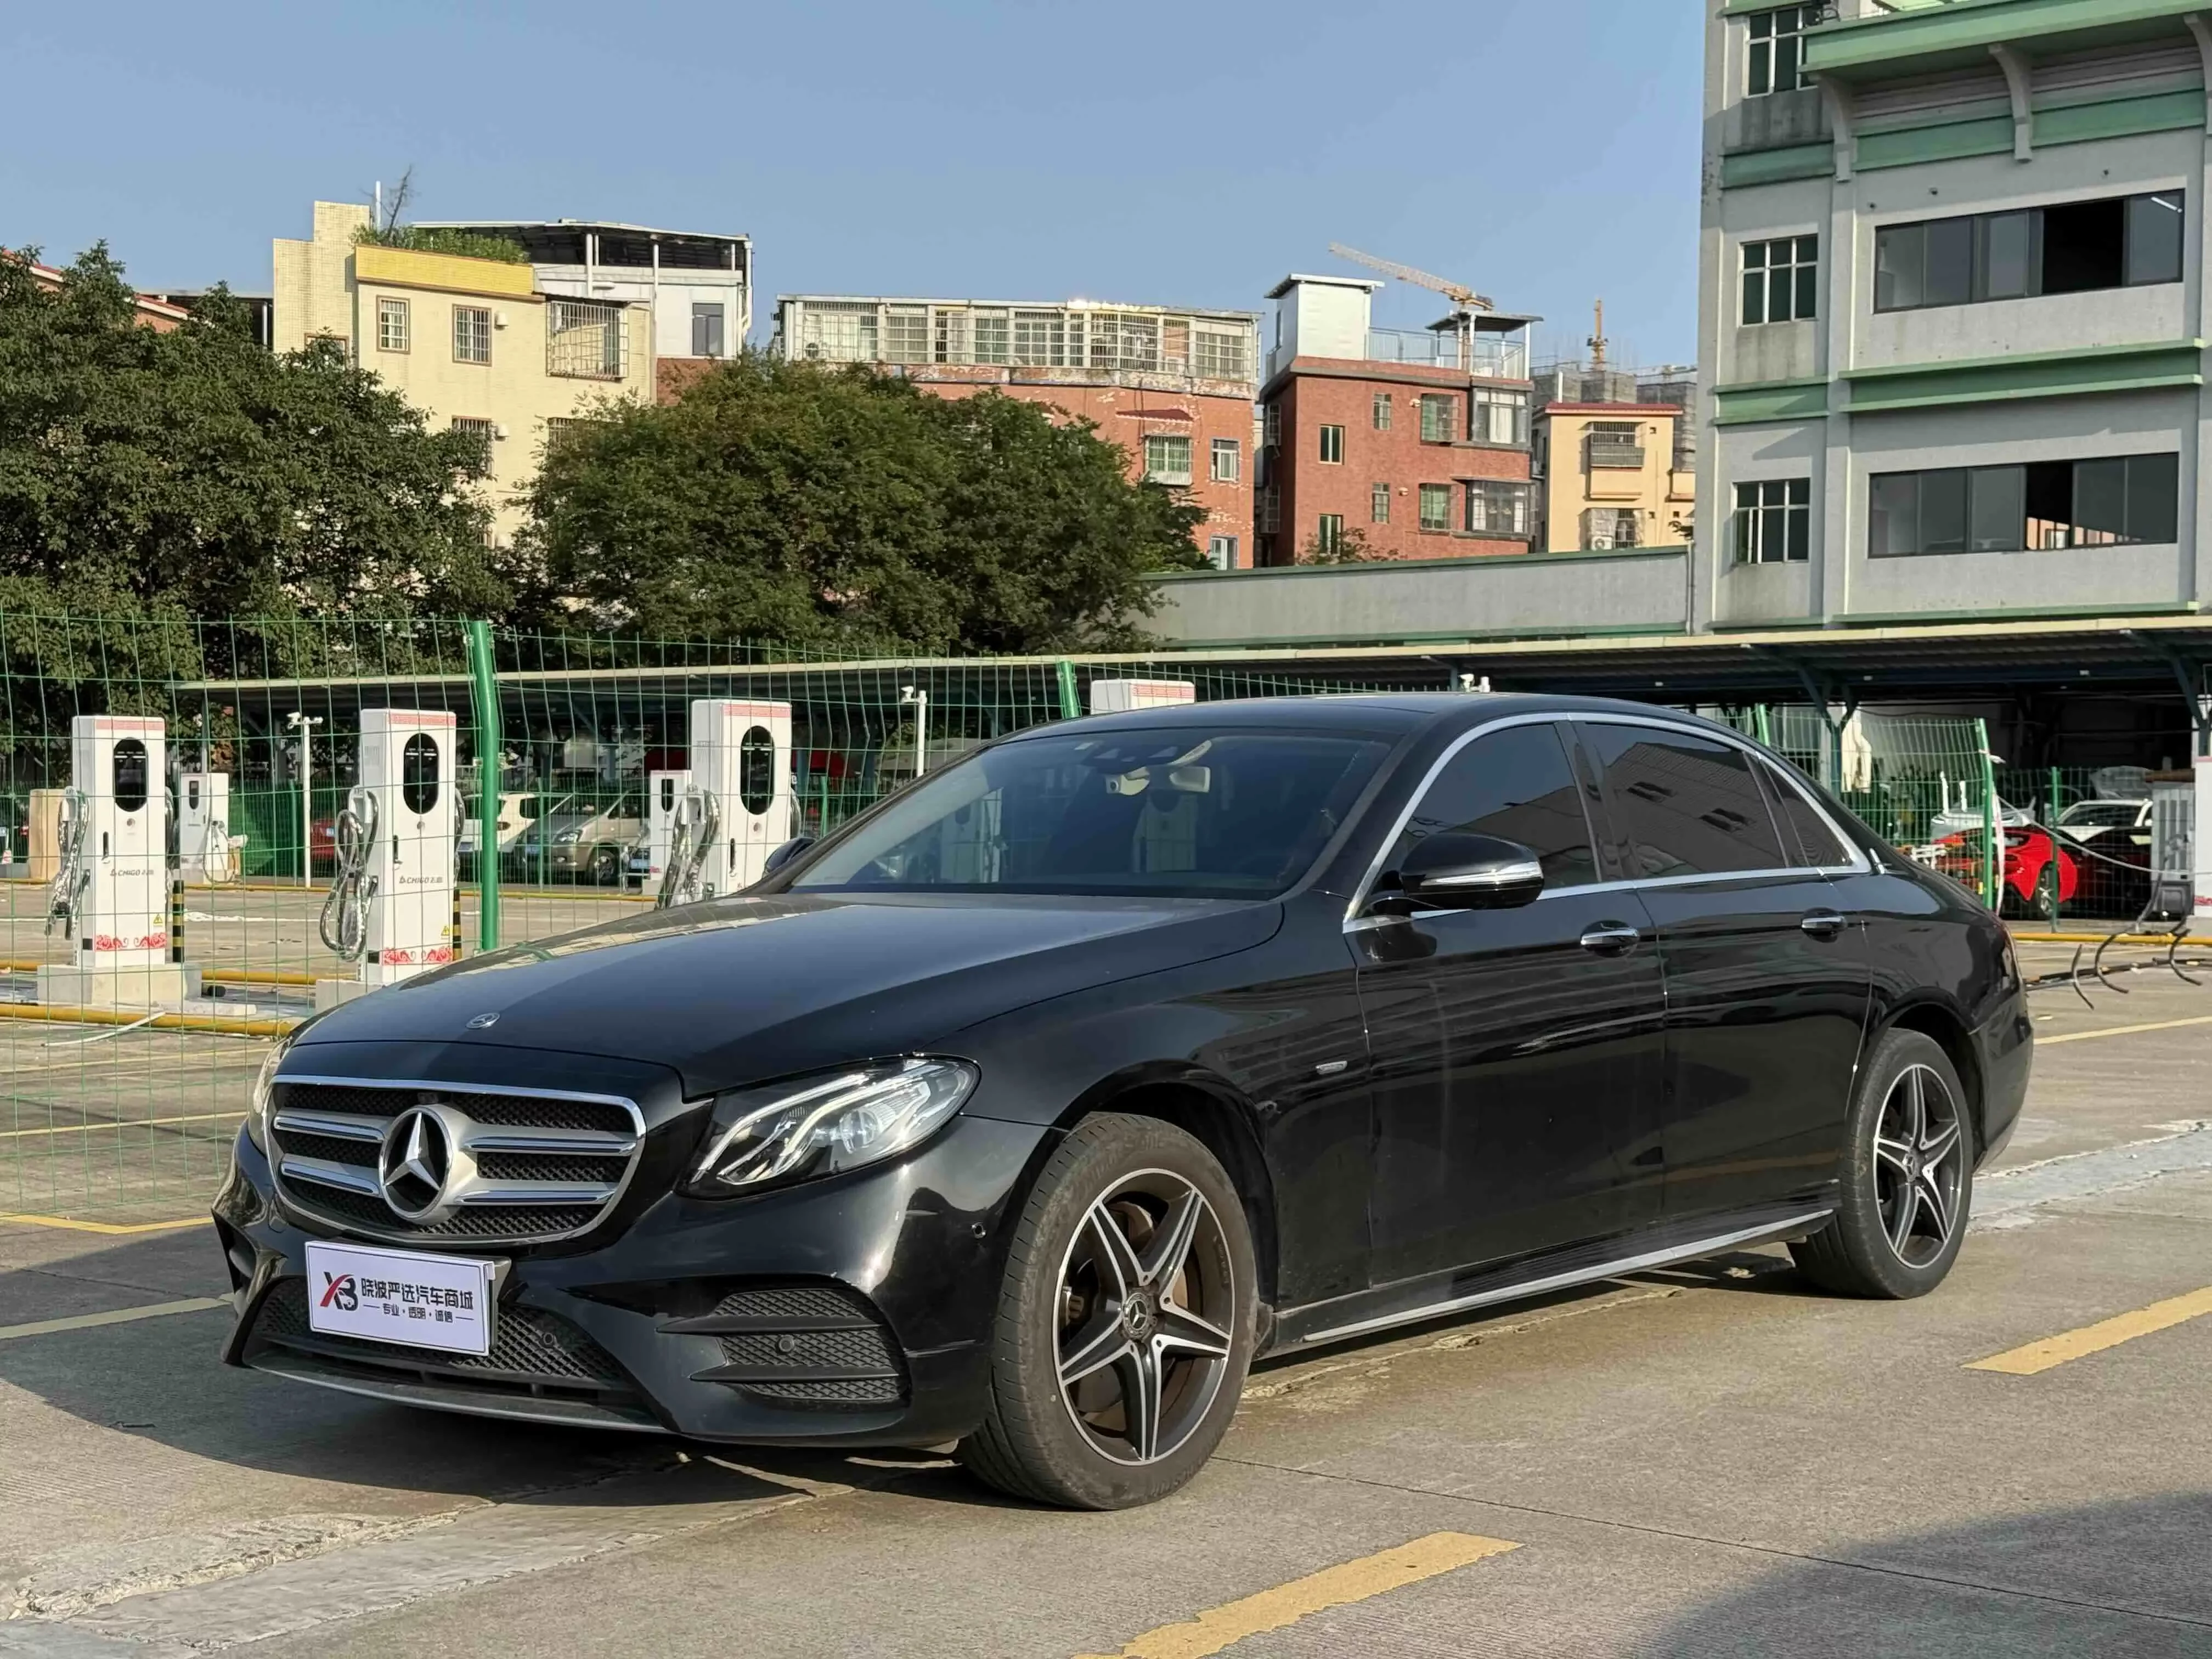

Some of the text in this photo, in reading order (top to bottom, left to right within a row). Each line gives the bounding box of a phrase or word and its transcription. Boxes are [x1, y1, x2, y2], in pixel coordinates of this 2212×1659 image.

[360, 1278, 474, 1310] 晓波严选汽车商城
